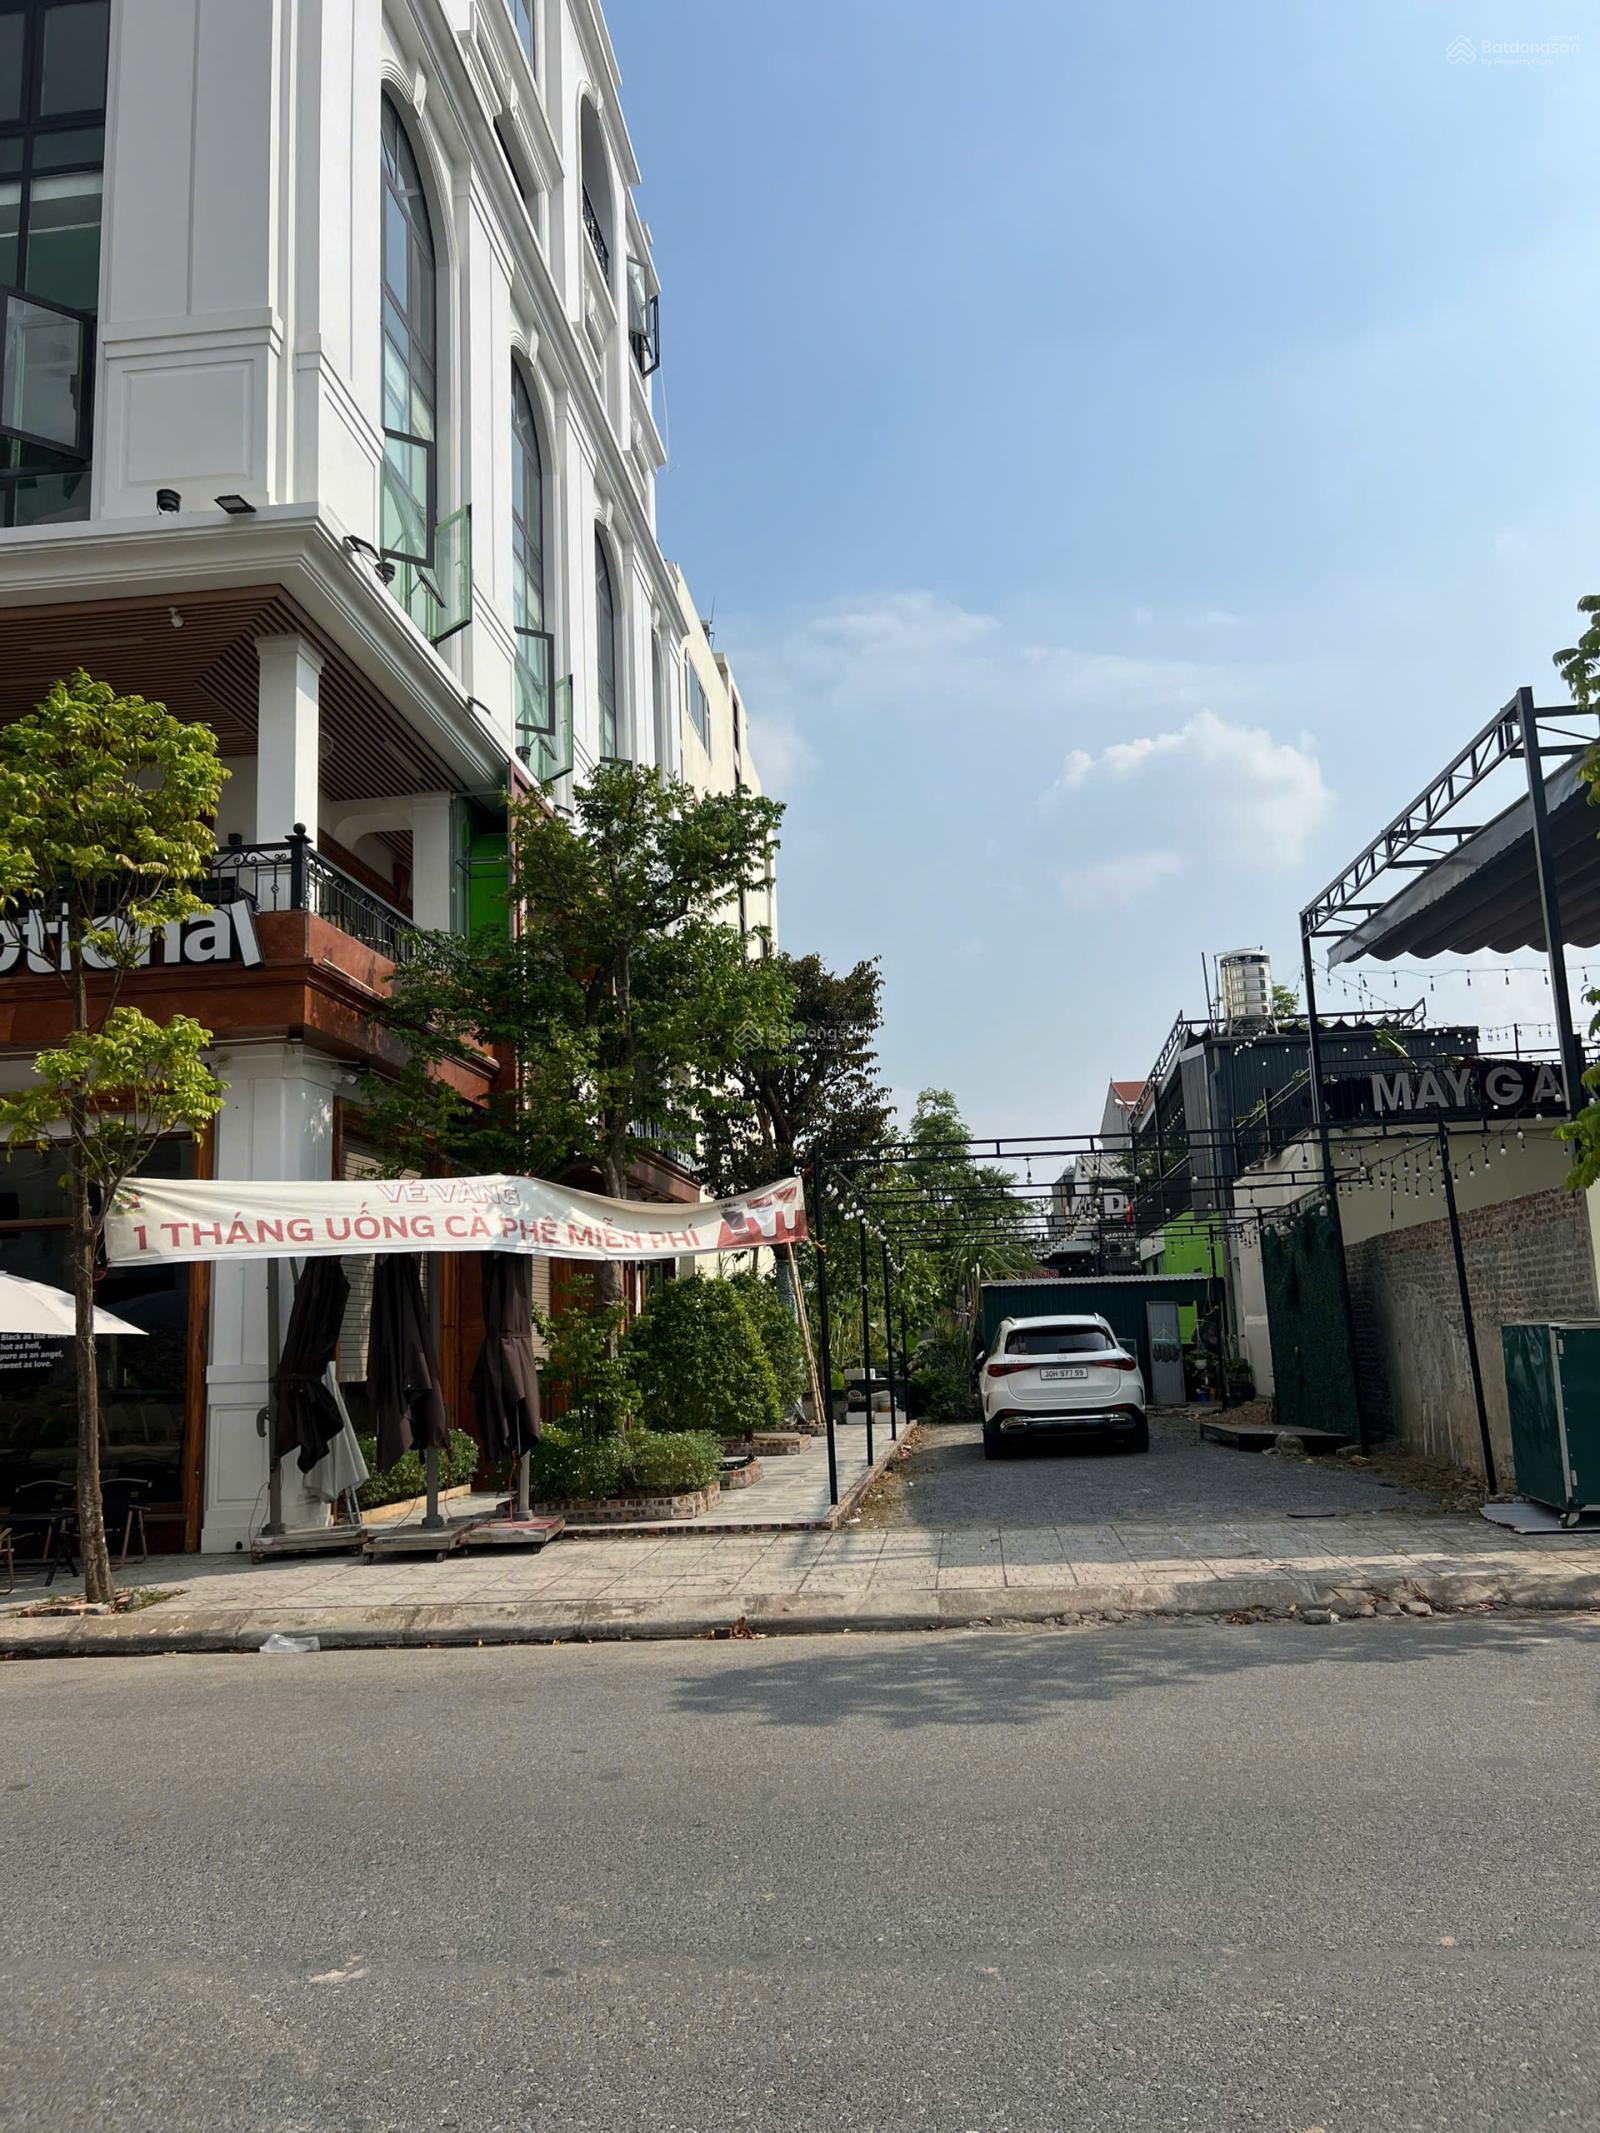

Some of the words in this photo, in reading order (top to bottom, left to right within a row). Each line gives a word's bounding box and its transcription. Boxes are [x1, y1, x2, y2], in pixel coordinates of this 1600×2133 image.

[1371, 1061, 1473, 1112] MÂY
[377, 1180, 428, 1203] VÉ
[430, 1179, 521, 1206] VÀNG
[133, 1225, 147, 1250] 1
[160, 1211, 315, 1248] THÁNG
[325, 1202, 436, 1241] UỐNG
[444, 1208, 492, 1238] CÀ
[499, 1216, 561, 1245] PHÊ
[567, 1216, 643, 1249] MIỄN
[647, 1223, 702, 1249] PHÍ
[0, 1342, 13, 1350] hot
[23, 1361, 33, 1369] as
